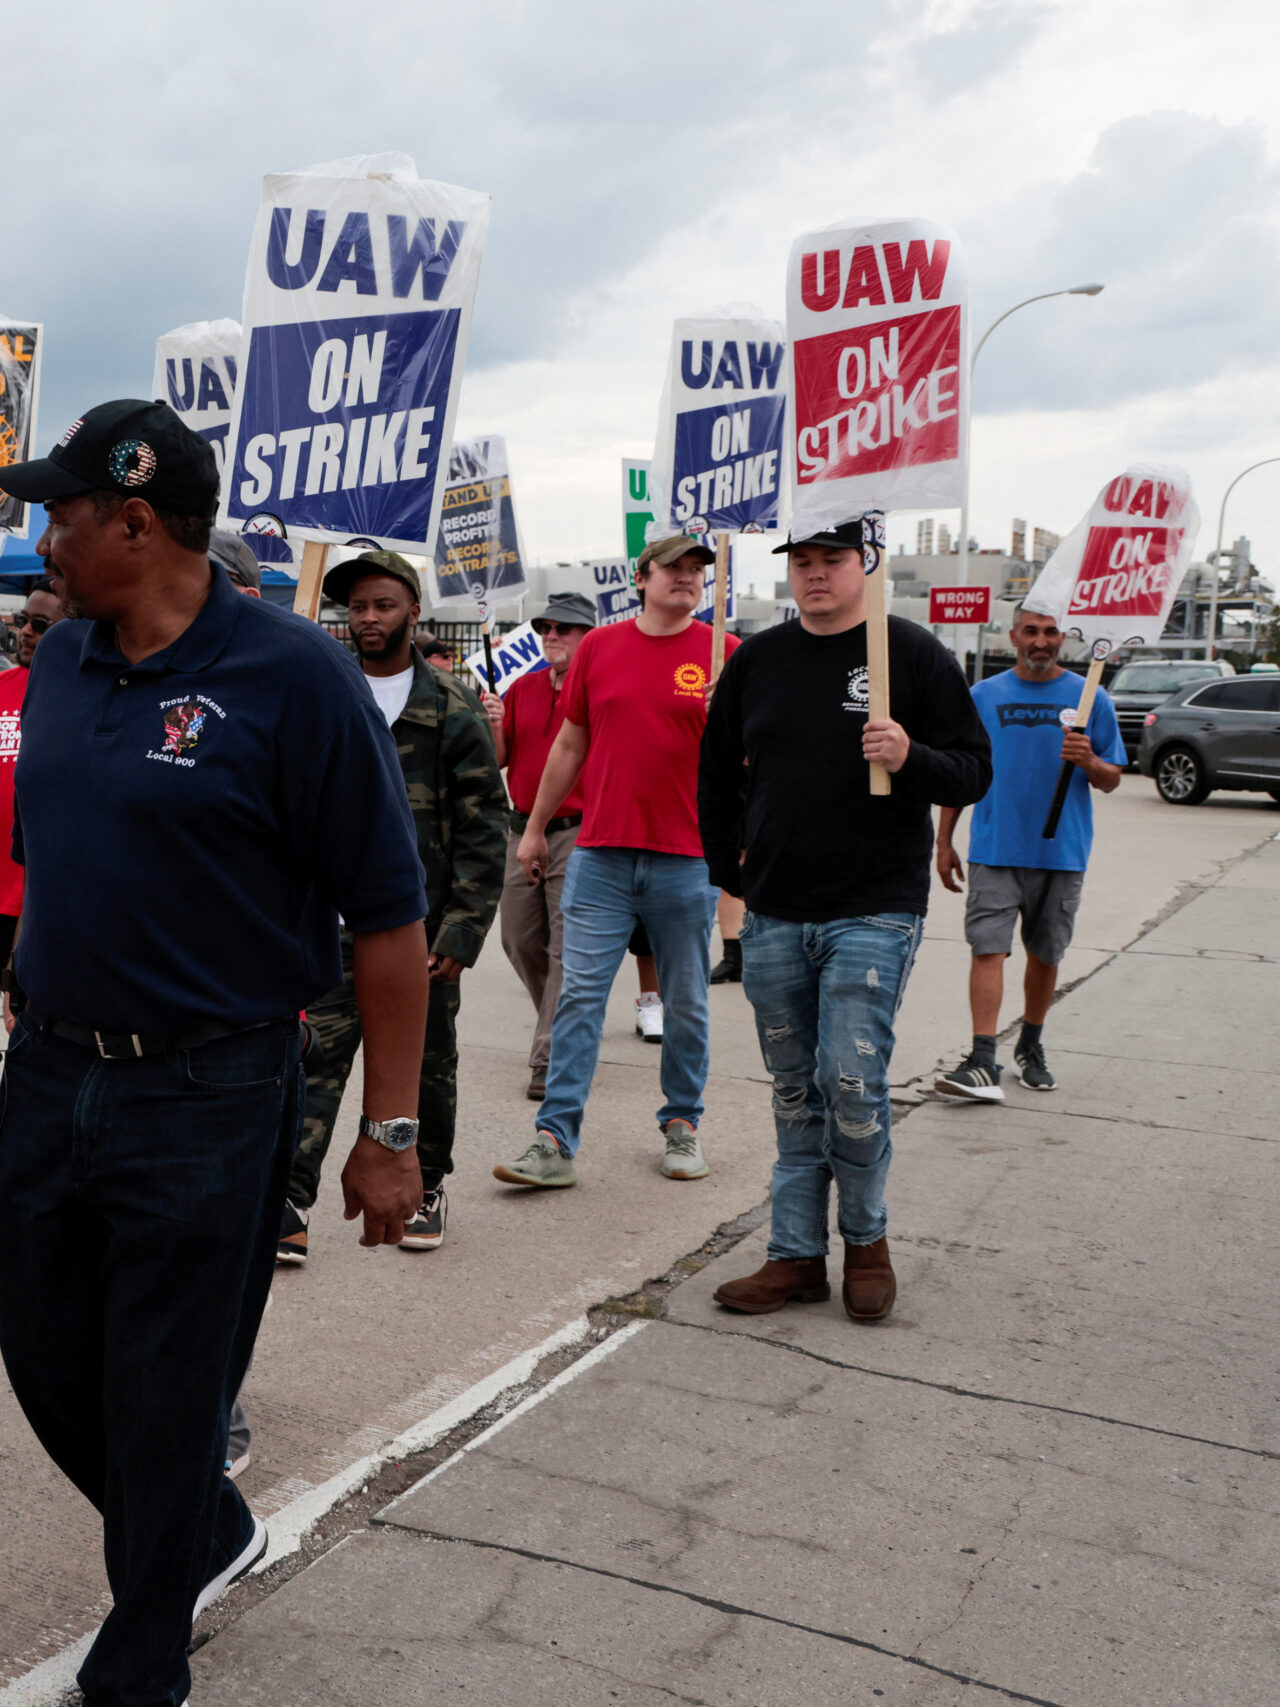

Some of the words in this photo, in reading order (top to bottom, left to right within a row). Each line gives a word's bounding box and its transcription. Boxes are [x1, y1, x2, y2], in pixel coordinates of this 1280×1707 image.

[266, 207, 469, 301] UAW
[801, 239, 951, 312] UAW
[308, 330, 387, 413] ON
[681, 340, 786, 390] UAW
[836, 326, 899, 399] ON
[711, 408, 751, 462] ON
[797, 365, 958, 477] STRIKE
[239, 405, 436, 507] STRIKE
[442, 488, 478, 508] TAND
[676, 448, 778, 522] STRIKE
[1109, 531, 1153, 569] ON
[610, 590, 629, 612] ON
[935, 591, 985, 605] WRONG
[1070, 562, 1169, 611] STRIKE
[943, 606, 974, 619] WAY
[476, 632, 540, 684] UAW
[159, 695, 190, 709] Proud
[196, 695, 227, 719] Veteran
[146, 749, 174, 763] Local
[174, 757, 195, 767] 900
